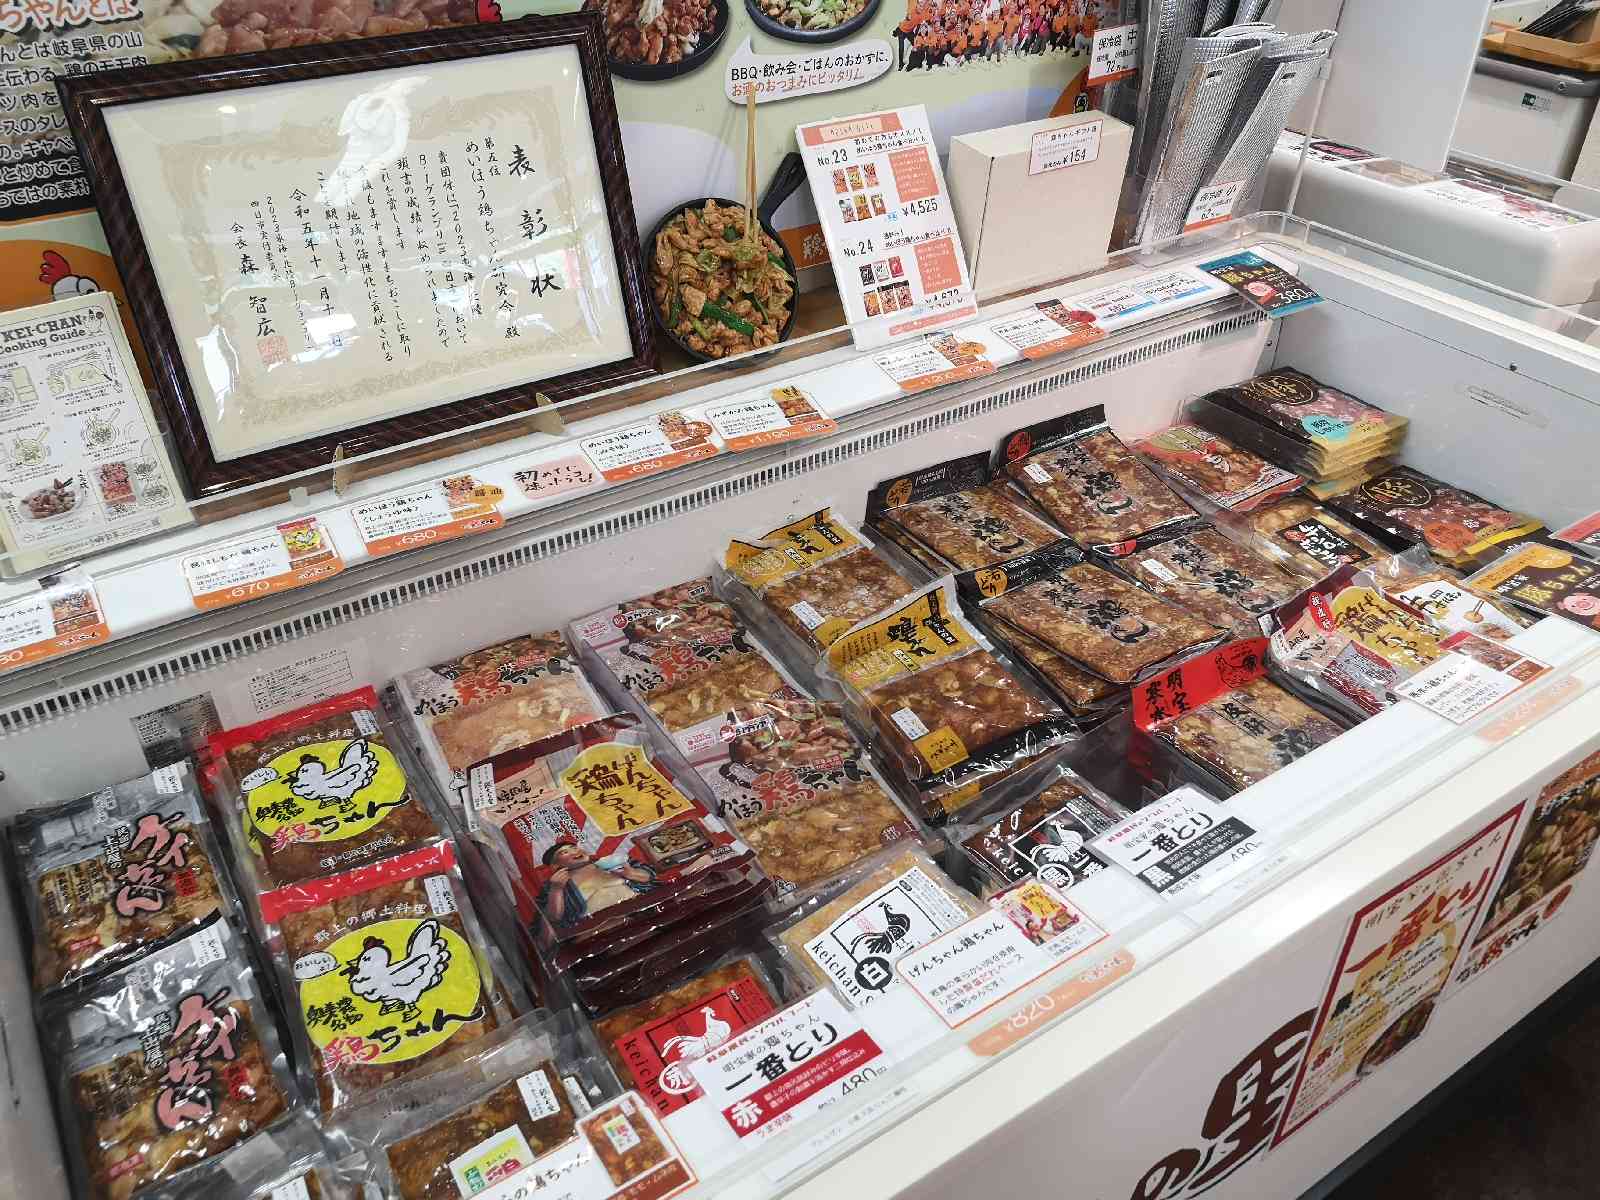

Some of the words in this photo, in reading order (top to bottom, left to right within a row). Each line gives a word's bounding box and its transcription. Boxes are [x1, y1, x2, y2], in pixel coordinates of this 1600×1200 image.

[508, 144, 562, 298] 表彰状
[902, 199, 939, 217] ¥4,525
[3, 314, 83, 343] KEI-CHAN
[50, 328, 86, 343] Guide
[1132, 812, 1213, 862] 一番とり
[724, 1021, 838, 1092] 一番とり
[731, 1099, 764, 1130] 赤
